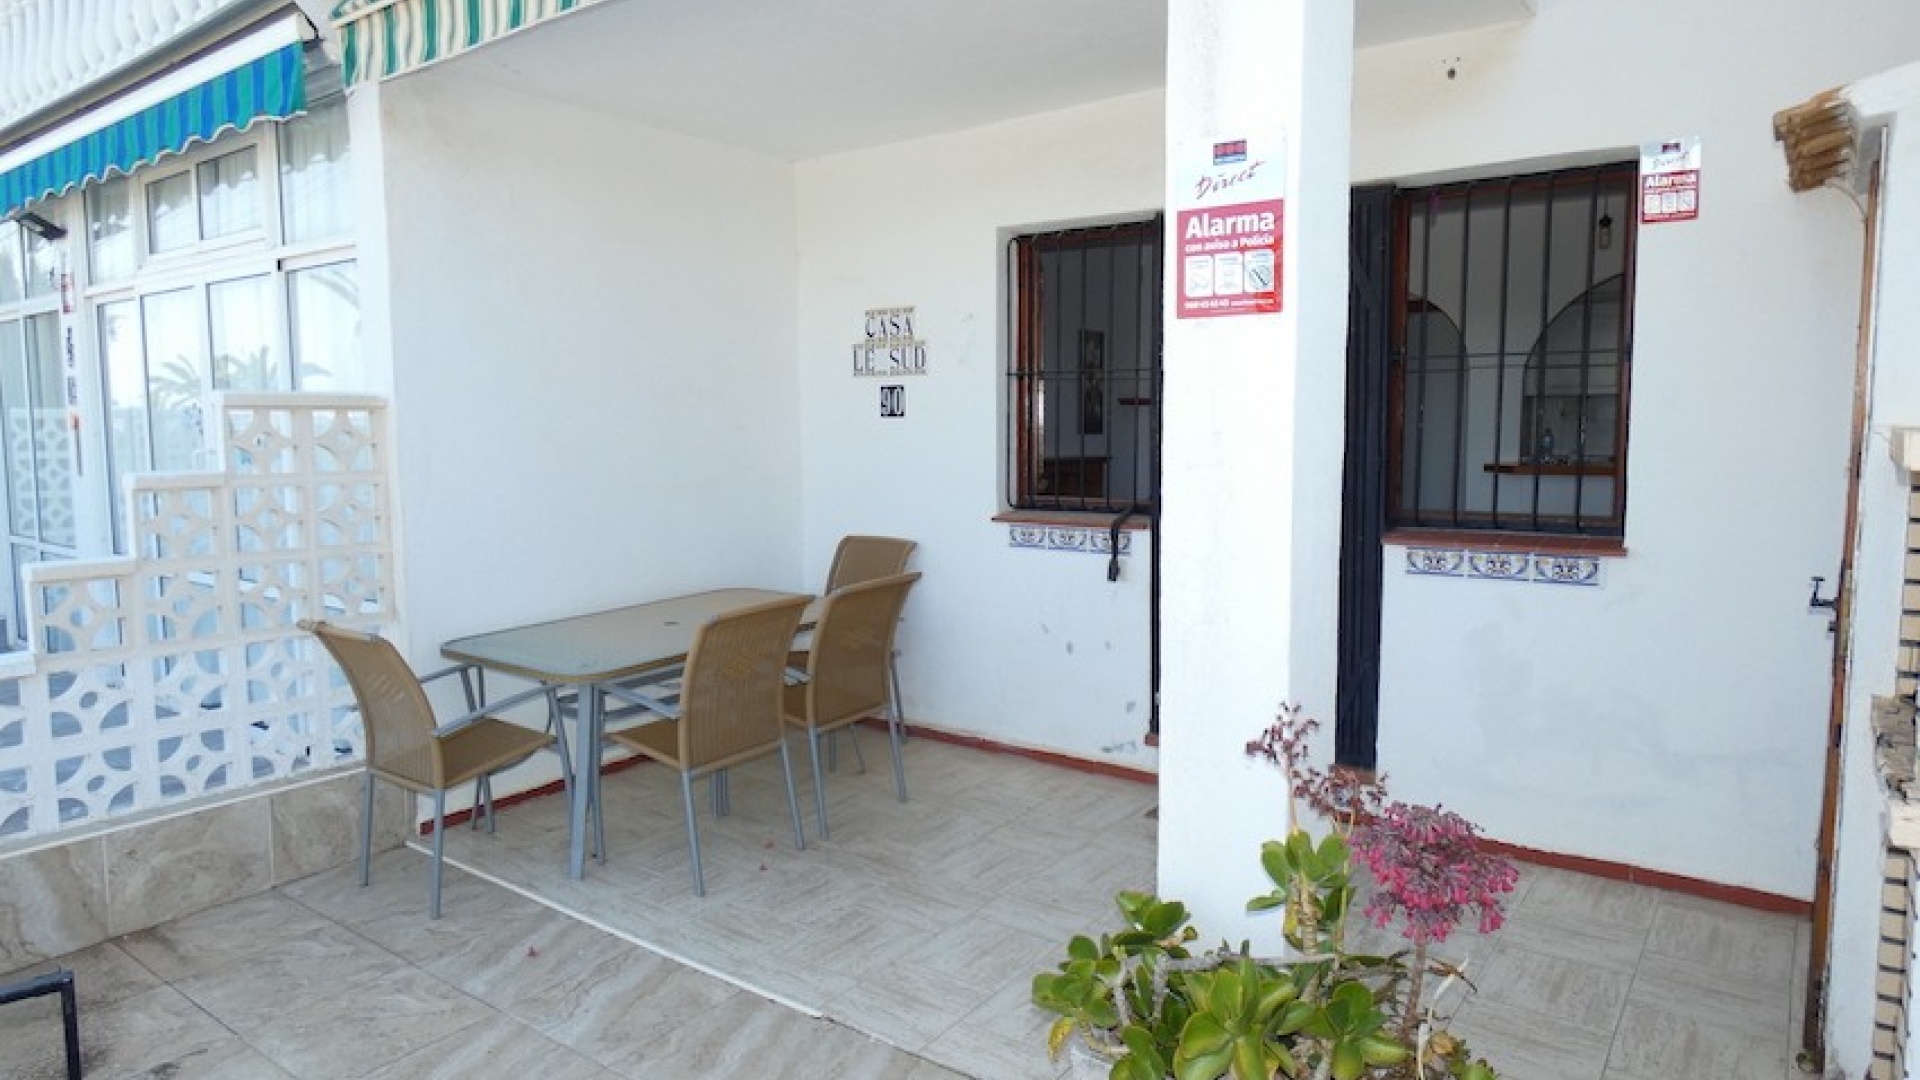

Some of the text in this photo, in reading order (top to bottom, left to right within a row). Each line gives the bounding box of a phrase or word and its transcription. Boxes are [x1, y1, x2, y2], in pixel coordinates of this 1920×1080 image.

[1185, 212, 1275, 239] Alarma
[865, 314, 913, 337] CASA
[853, 344, 926, 371] LE SUD
[880, 386, 904, 416] 90
